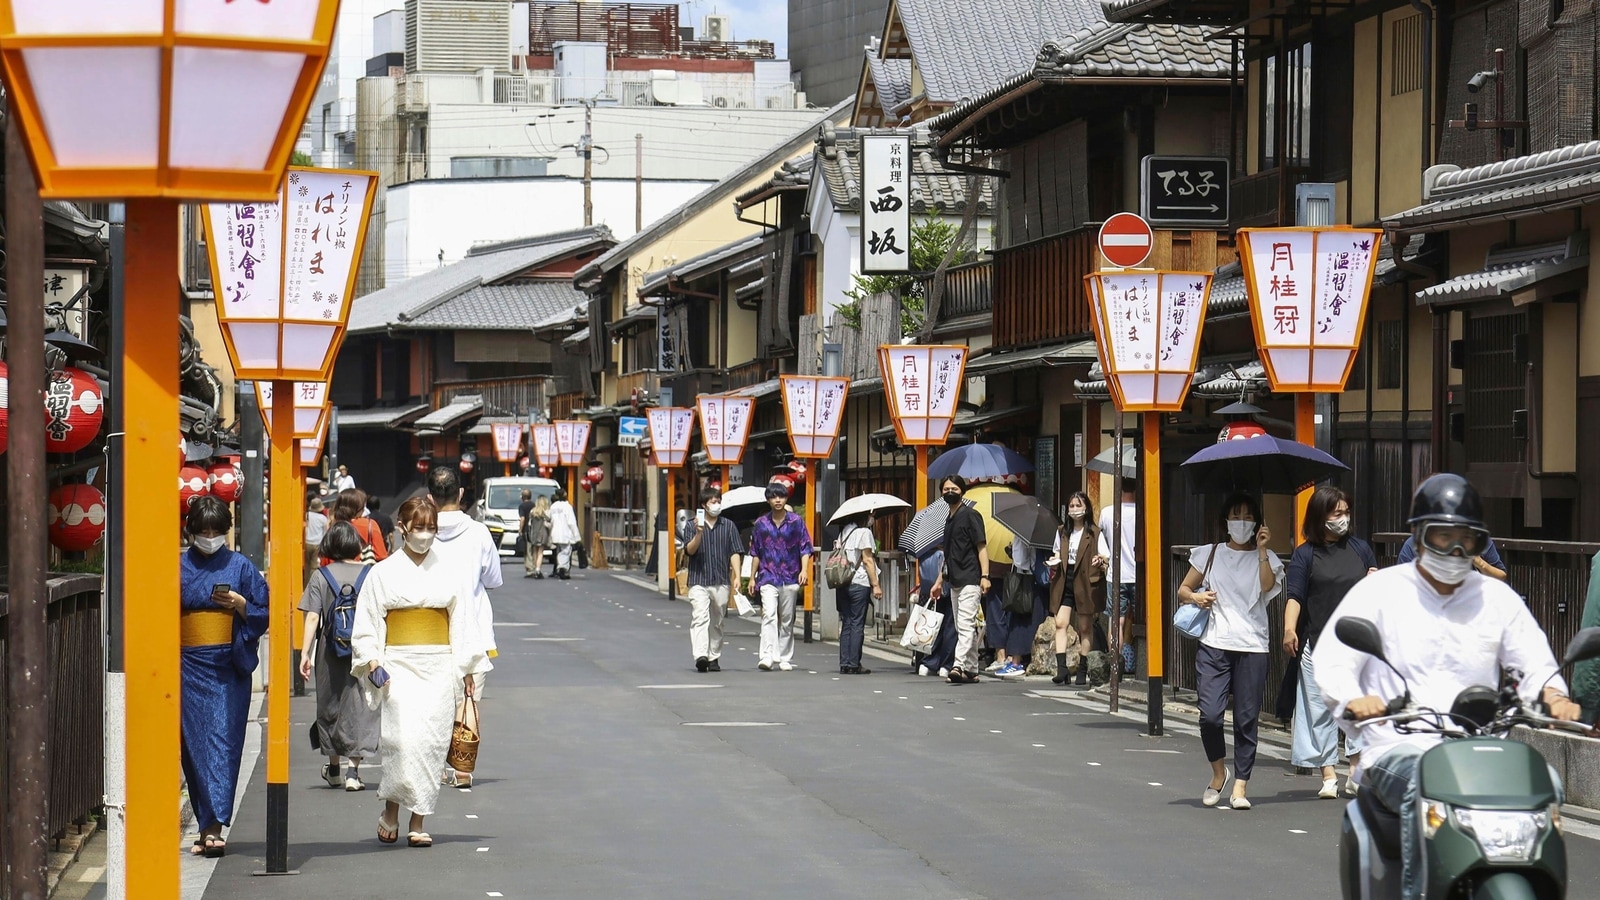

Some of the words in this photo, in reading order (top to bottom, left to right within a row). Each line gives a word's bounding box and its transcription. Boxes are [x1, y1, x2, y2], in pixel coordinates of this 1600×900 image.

[890, 143, 902, 183] 京料理
[1156, 169, 1220, 197] てる子
[309, 190, 335, 275] はれま
[334, 181, 352, 249] チリメン山椒
[867, 186, 905, 255] 西坂
[1124, 286, 1142, 342] はれま
[1269, 242, 1300, 335] 月桂冠
[901, 355, 921, 411] 月桂冠
